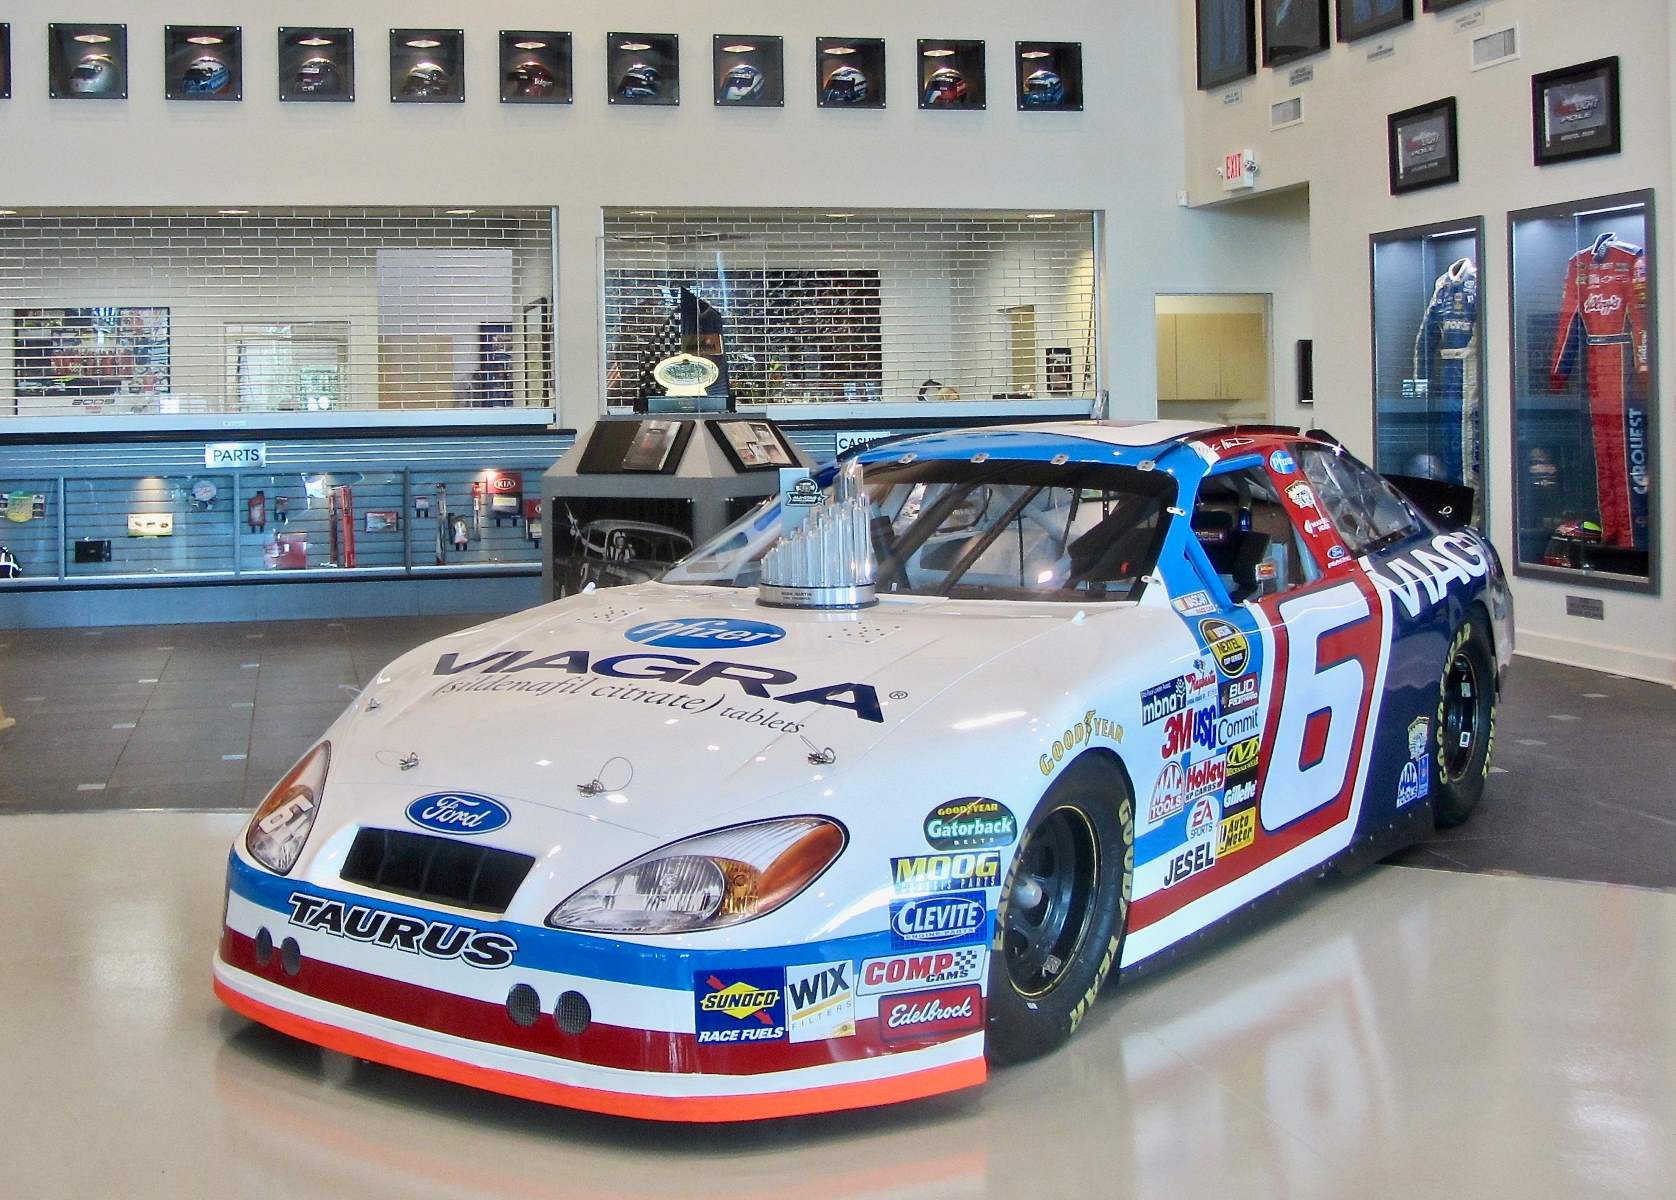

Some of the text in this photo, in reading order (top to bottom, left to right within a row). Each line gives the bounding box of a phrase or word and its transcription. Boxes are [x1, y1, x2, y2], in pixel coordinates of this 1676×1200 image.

[1226, 153, 1242, 181] EXIT
[212, 448, 260, 463] PARTS
[497, 480, 512, 488] KIA
[433, 650, 885, 723] VIAGRA
[1229, 678, 1255, 696] BUD
[605, 682, 726, 716] citrate)
[721, 705, 803, 735] tablets
[1143, 691, 1177, 725] mbna
[1261, 581, 1371, 833] 6
[1161, 708, 1194, 760] 3M
[1192, 704, 1217, 751] USG
[1217, 706, 1260, 746] Commit
[1186, 760, 1225, 793] Holley
[1151, 792, 1182, 819] TOOLS
[1223, 780, 1257, 808] Gillette
[422, 796, 491, 828] Ford
[937, 803, 998, 816] GOODYEAR
[1191, 799, 1213, 827] EA
[927, 816, 1012, 839] Gatorback
[1190, 821, 1213, 840] SPORTS
[1225, 826, 1253, 848] Meter
[1227, 815, 1249, 833] Auto
[953, 837, 995, 846] BELTS
[896, 851, 999, 882] MOOG
[1163, 841, 1214, 887] JESEL
[960, 876, 996, 889] PARTS
[288, 891, 519, 969] TAURUS
[897, 901, 979, 934] CLEVITE
[905, 927, 976, 940] ENGINE PARTS
[864, 953, 954, 986] COMP
[925, 969, 969, 983] CAMS
[704, 991, 777, 1009] SUNOCO
[788, 962, 850, 1011] WIX
[791, 1000, 853, 1031] FILTERS
[887, 996, 973, 1029] Edelbrock
[698, 1026, 784, 1043] RACE FUELS
